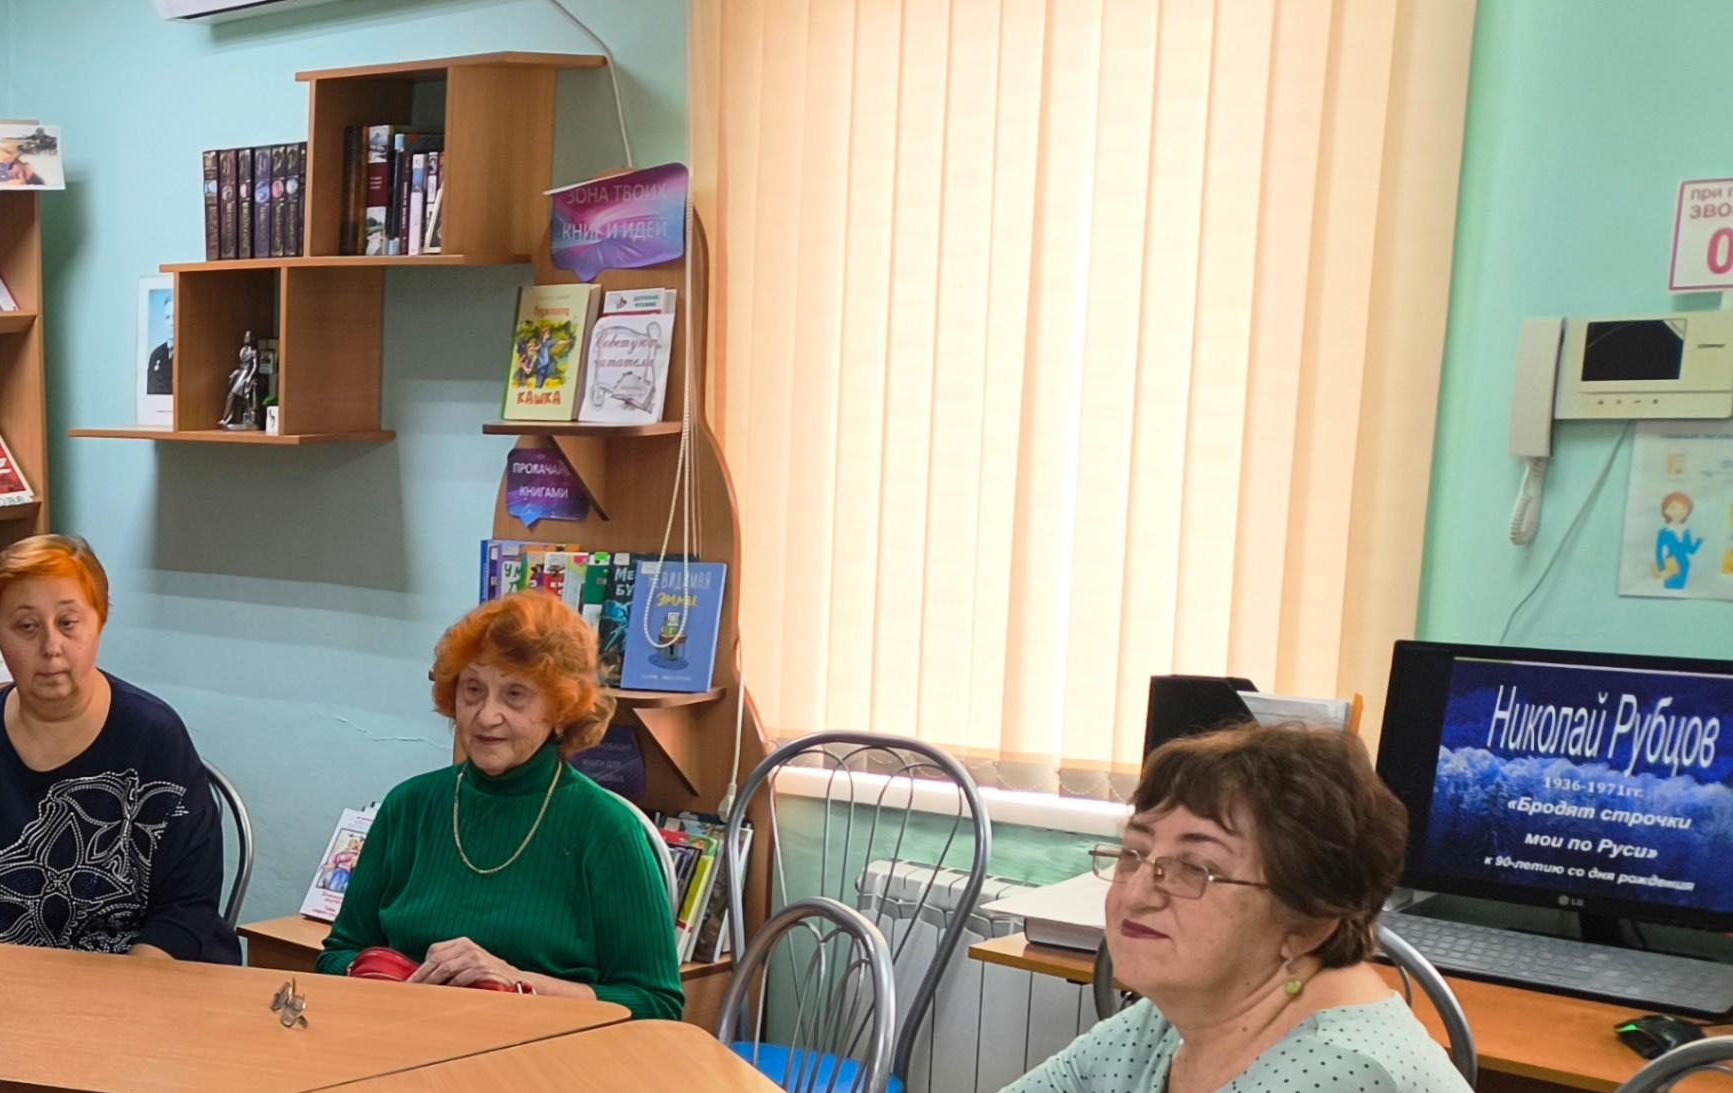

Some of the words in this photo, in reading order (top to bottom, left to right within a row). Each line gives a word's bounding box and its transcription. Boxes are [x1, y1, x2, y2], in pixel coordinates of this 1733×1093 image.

[567, 185, 609, 205] ЗОНА
[613, 182, 668, 201] ТВОИХ
[620, 219, 668, 242] ИДЕЙ
[519, 485, 568, 499] КНИГАМИ
[1486, 684, 1609, 760] Николай
[1607, 692, 1721, 778] Рубцов
[1542, 775, 1645, 800] 1936-1971гг.
[1507, 795, 1597, 820] «Бродят
[1600, 807, 1693, 830] строчки
[1524, 832, 1563, 850] мои
[1567, 837, 1593, 853] по
[1596, 837, 1659, 861] Руси»
[1483, 855, 1494, 866] к
[1494, 855, 1565, 876] 90-летию
[1567, 865, 1585, 878] со
[1587, 866, 1615, 882] дня
[1616, 871, 1696, 893] рождения
[1571, 897, 1585, 907] LG
